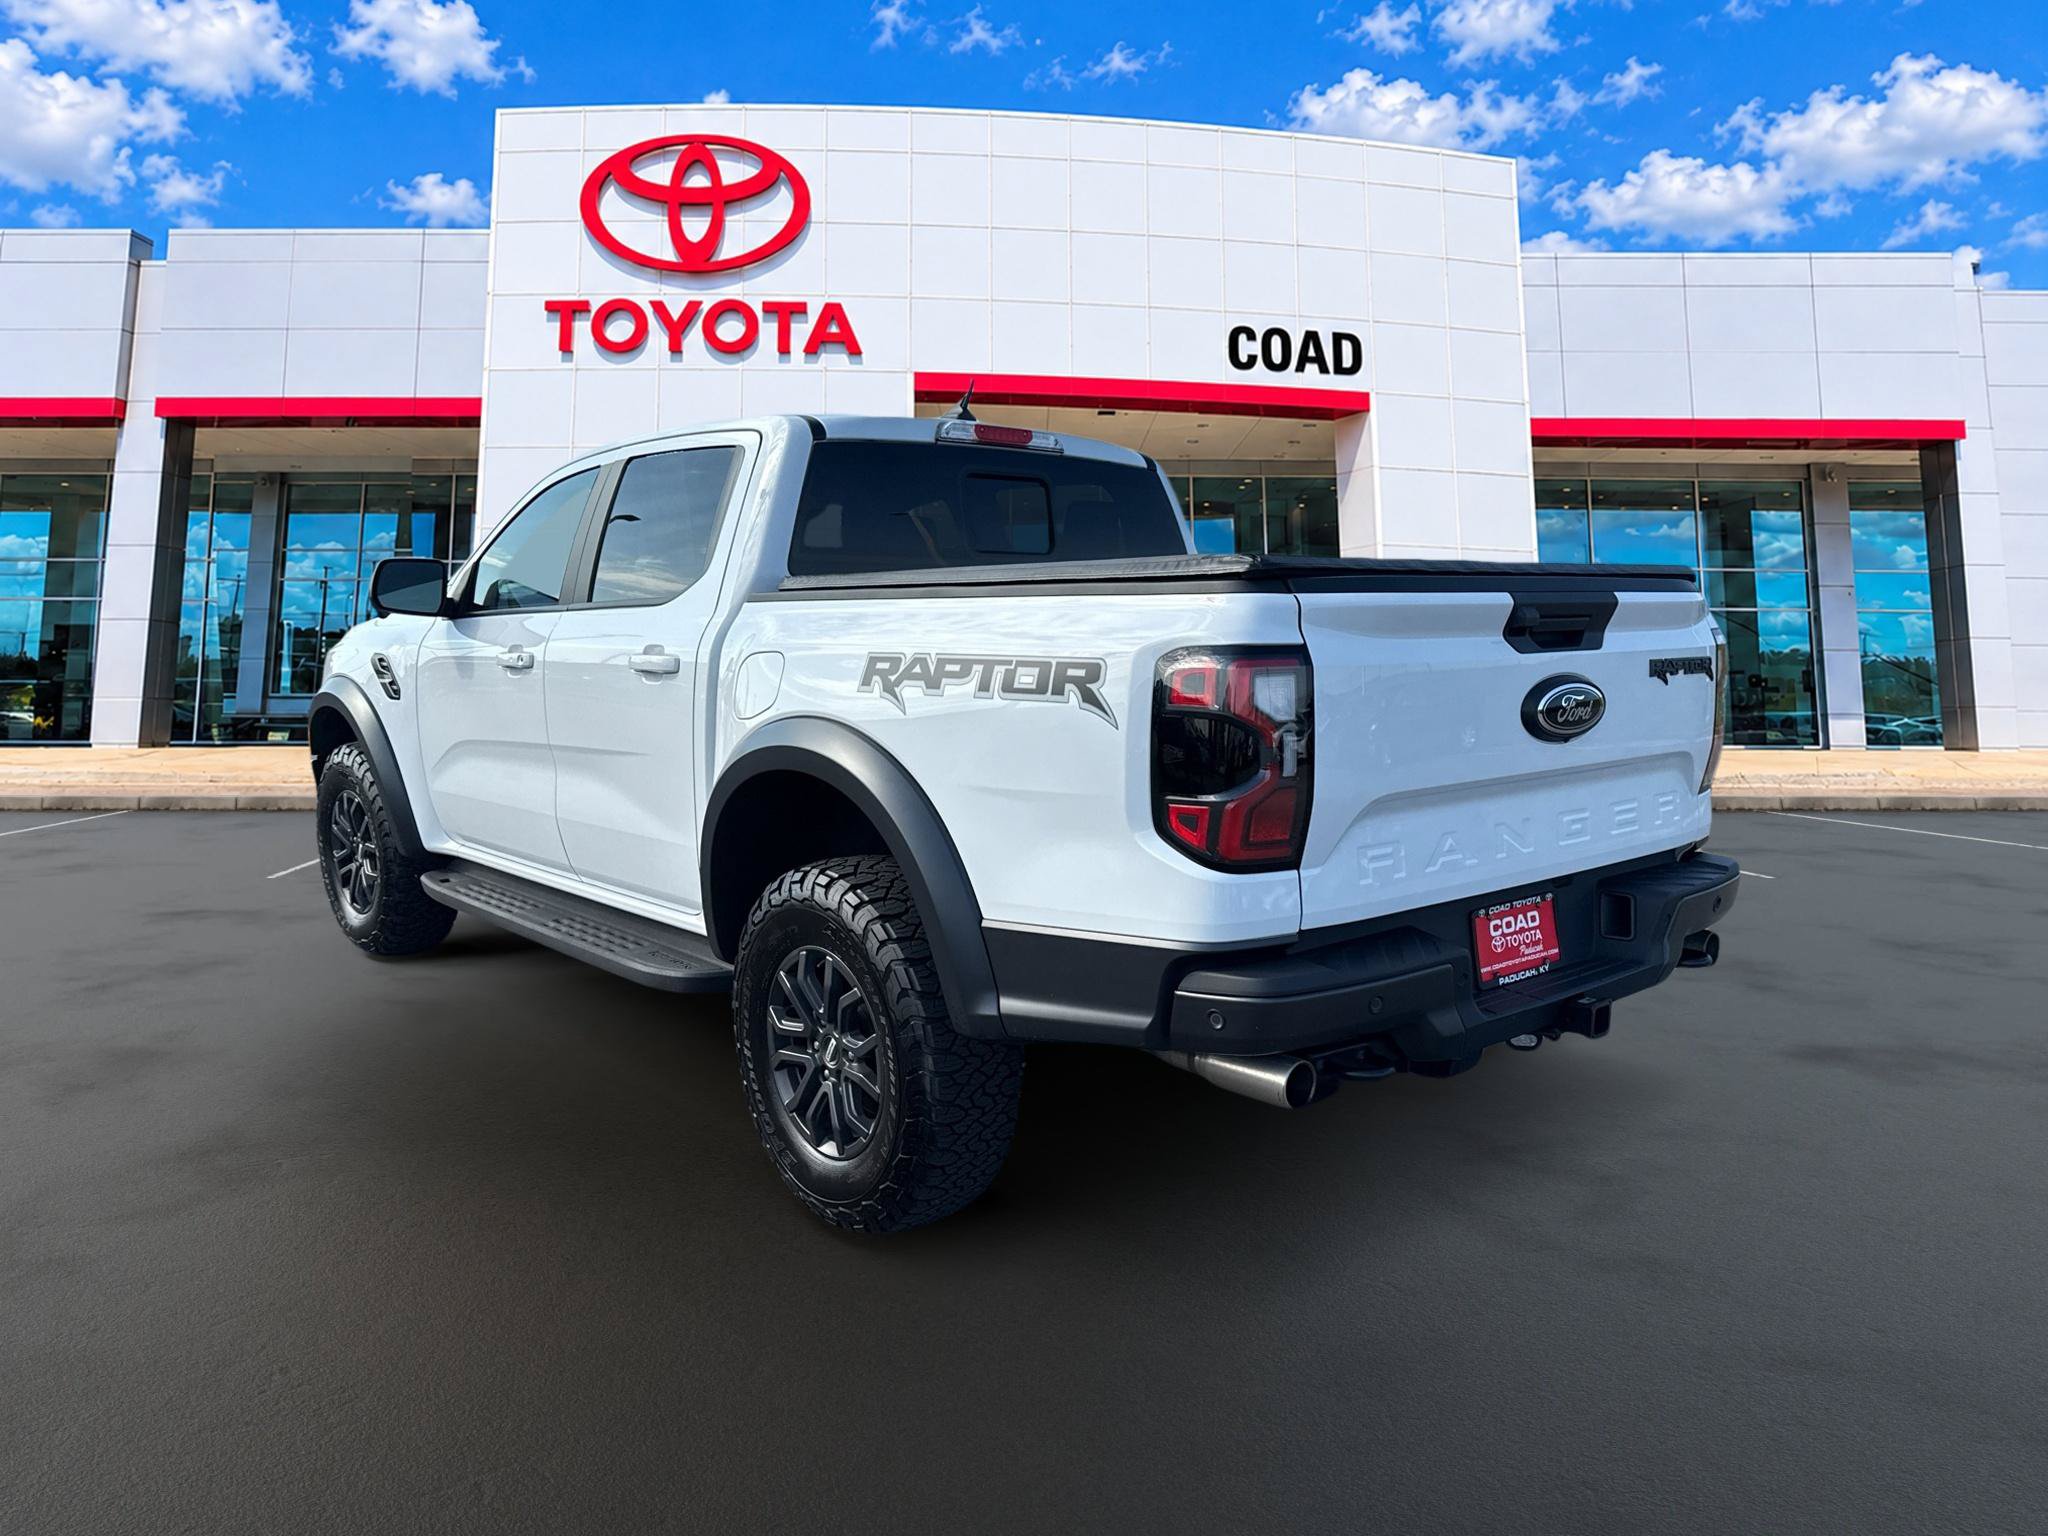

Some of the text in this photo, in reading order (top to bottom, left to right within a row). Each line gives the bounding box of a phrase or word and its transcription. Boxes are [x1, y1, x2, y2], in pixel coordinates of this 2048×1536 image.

[544, 298, 863, 355] TOYOTA
[1228, 325, 1363, 376] COAD
[1649, 656, 1714, 686] RAPTOR
[857, 652, 1119, 731] RAPTOR
[1557, 694, 1594, 723] Ford
[1357, 790, 1681, 887] RANGER
[1488, 896, 1541, 915] COAD TOYOTA
[1489, 910, 1540, 937] COAD
[1506, 929, 1543, 948] TOYOTA
[1539, 964, 1550, 974] KY
